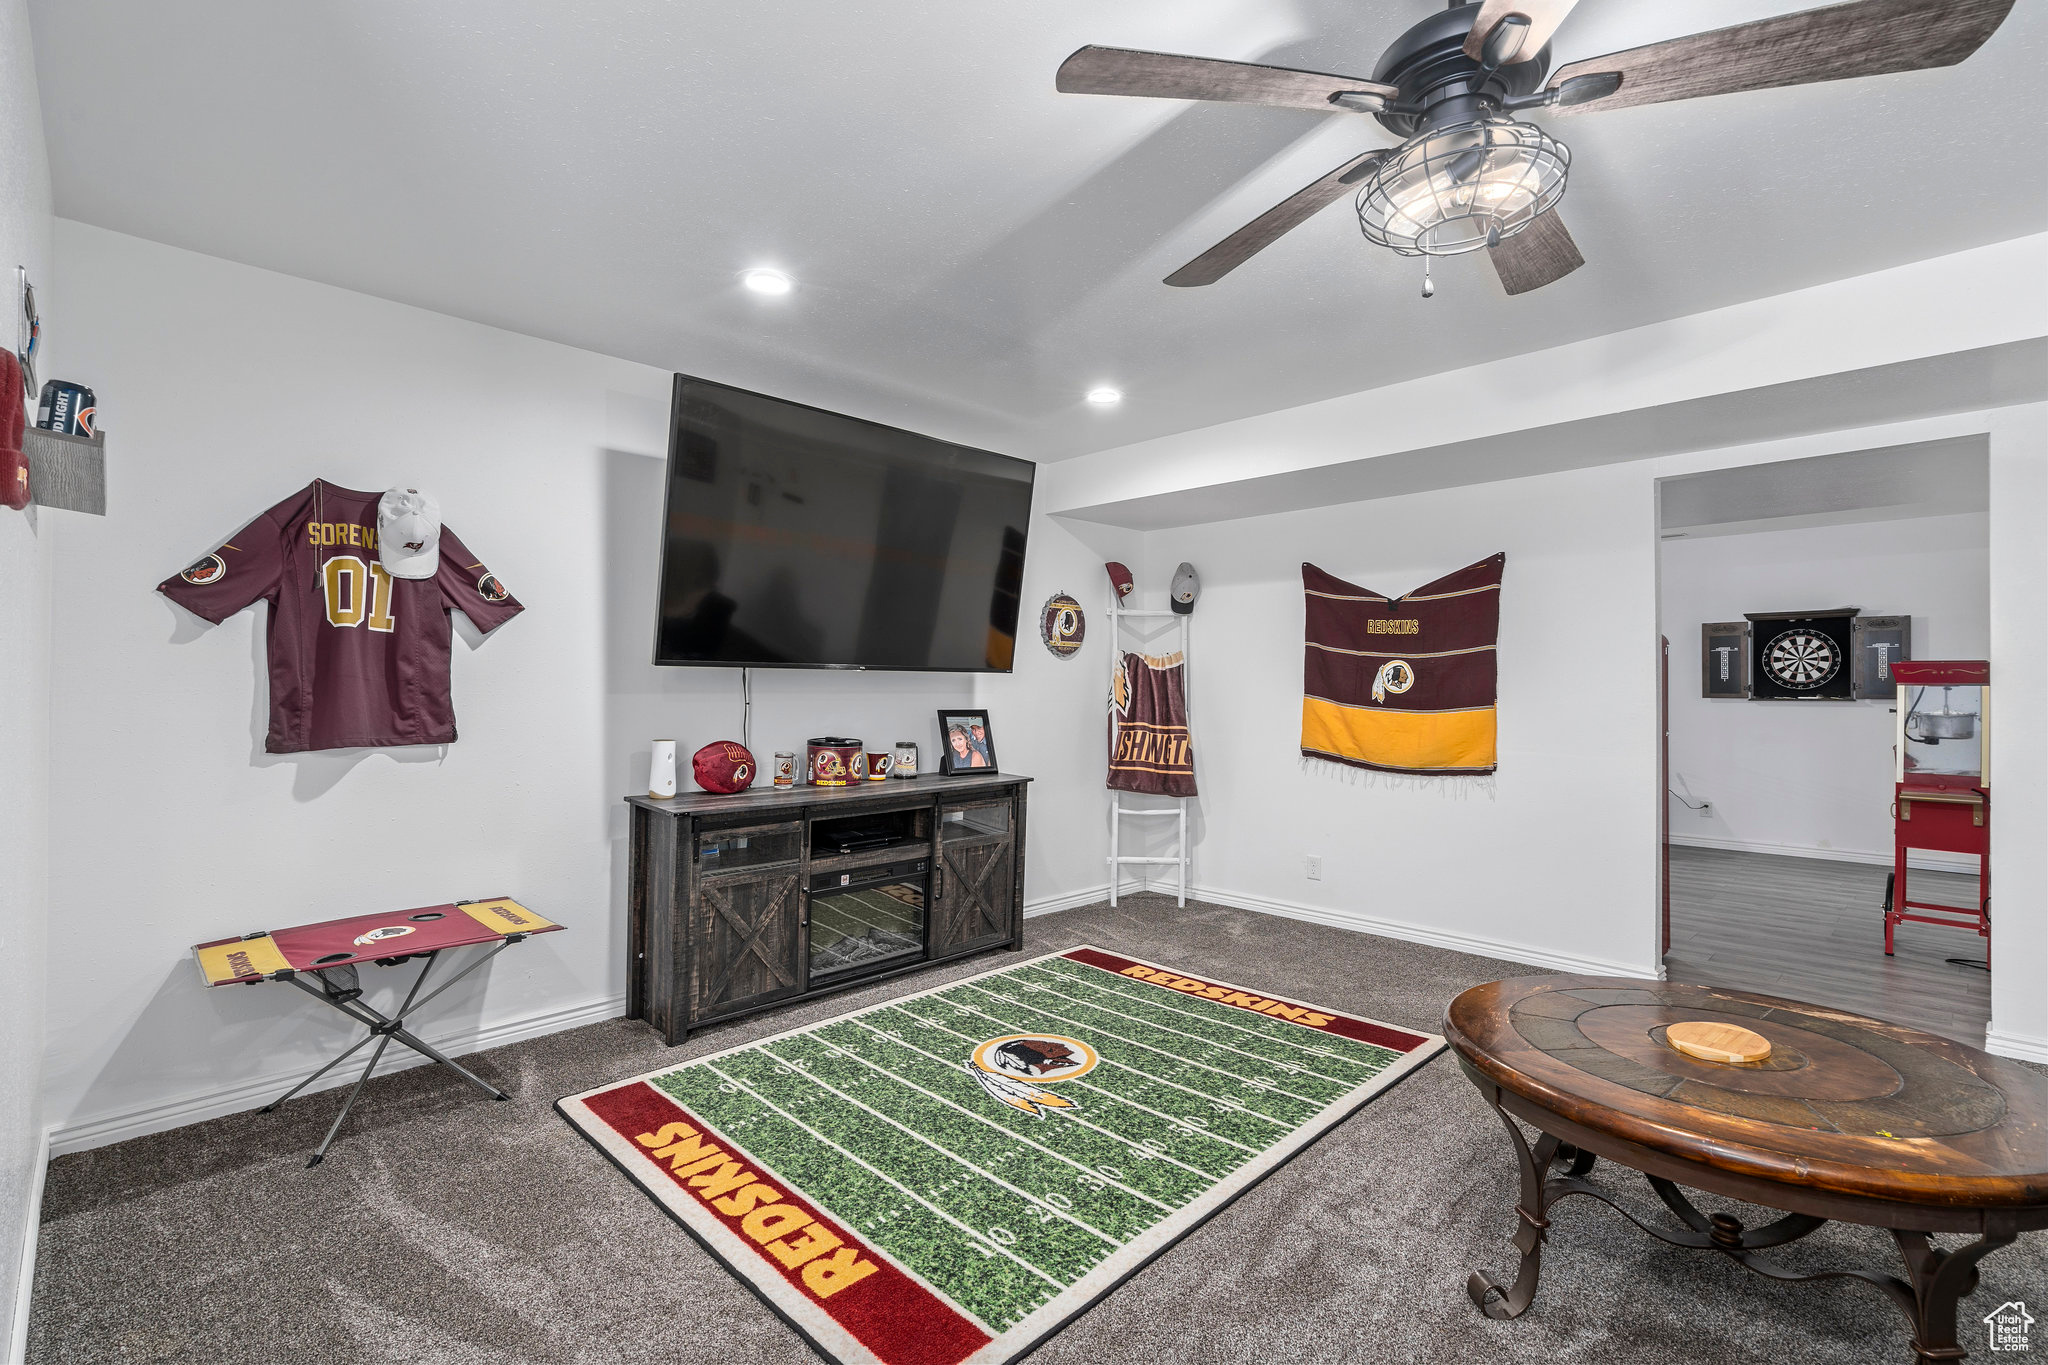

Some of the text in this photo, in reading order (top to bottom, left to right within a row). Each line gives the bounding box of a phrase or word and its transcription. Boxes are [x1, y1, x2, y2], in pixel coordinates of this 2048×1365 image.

[54, 390, 69, 421] LIGHT
[322, 555, 396, 633] 01
[1367, 619, 1419, 634] REDSKINS
[1120, 965, 1336, 1027] REDSKINS
[634, 1121, 880, 1299] REDSKINS
